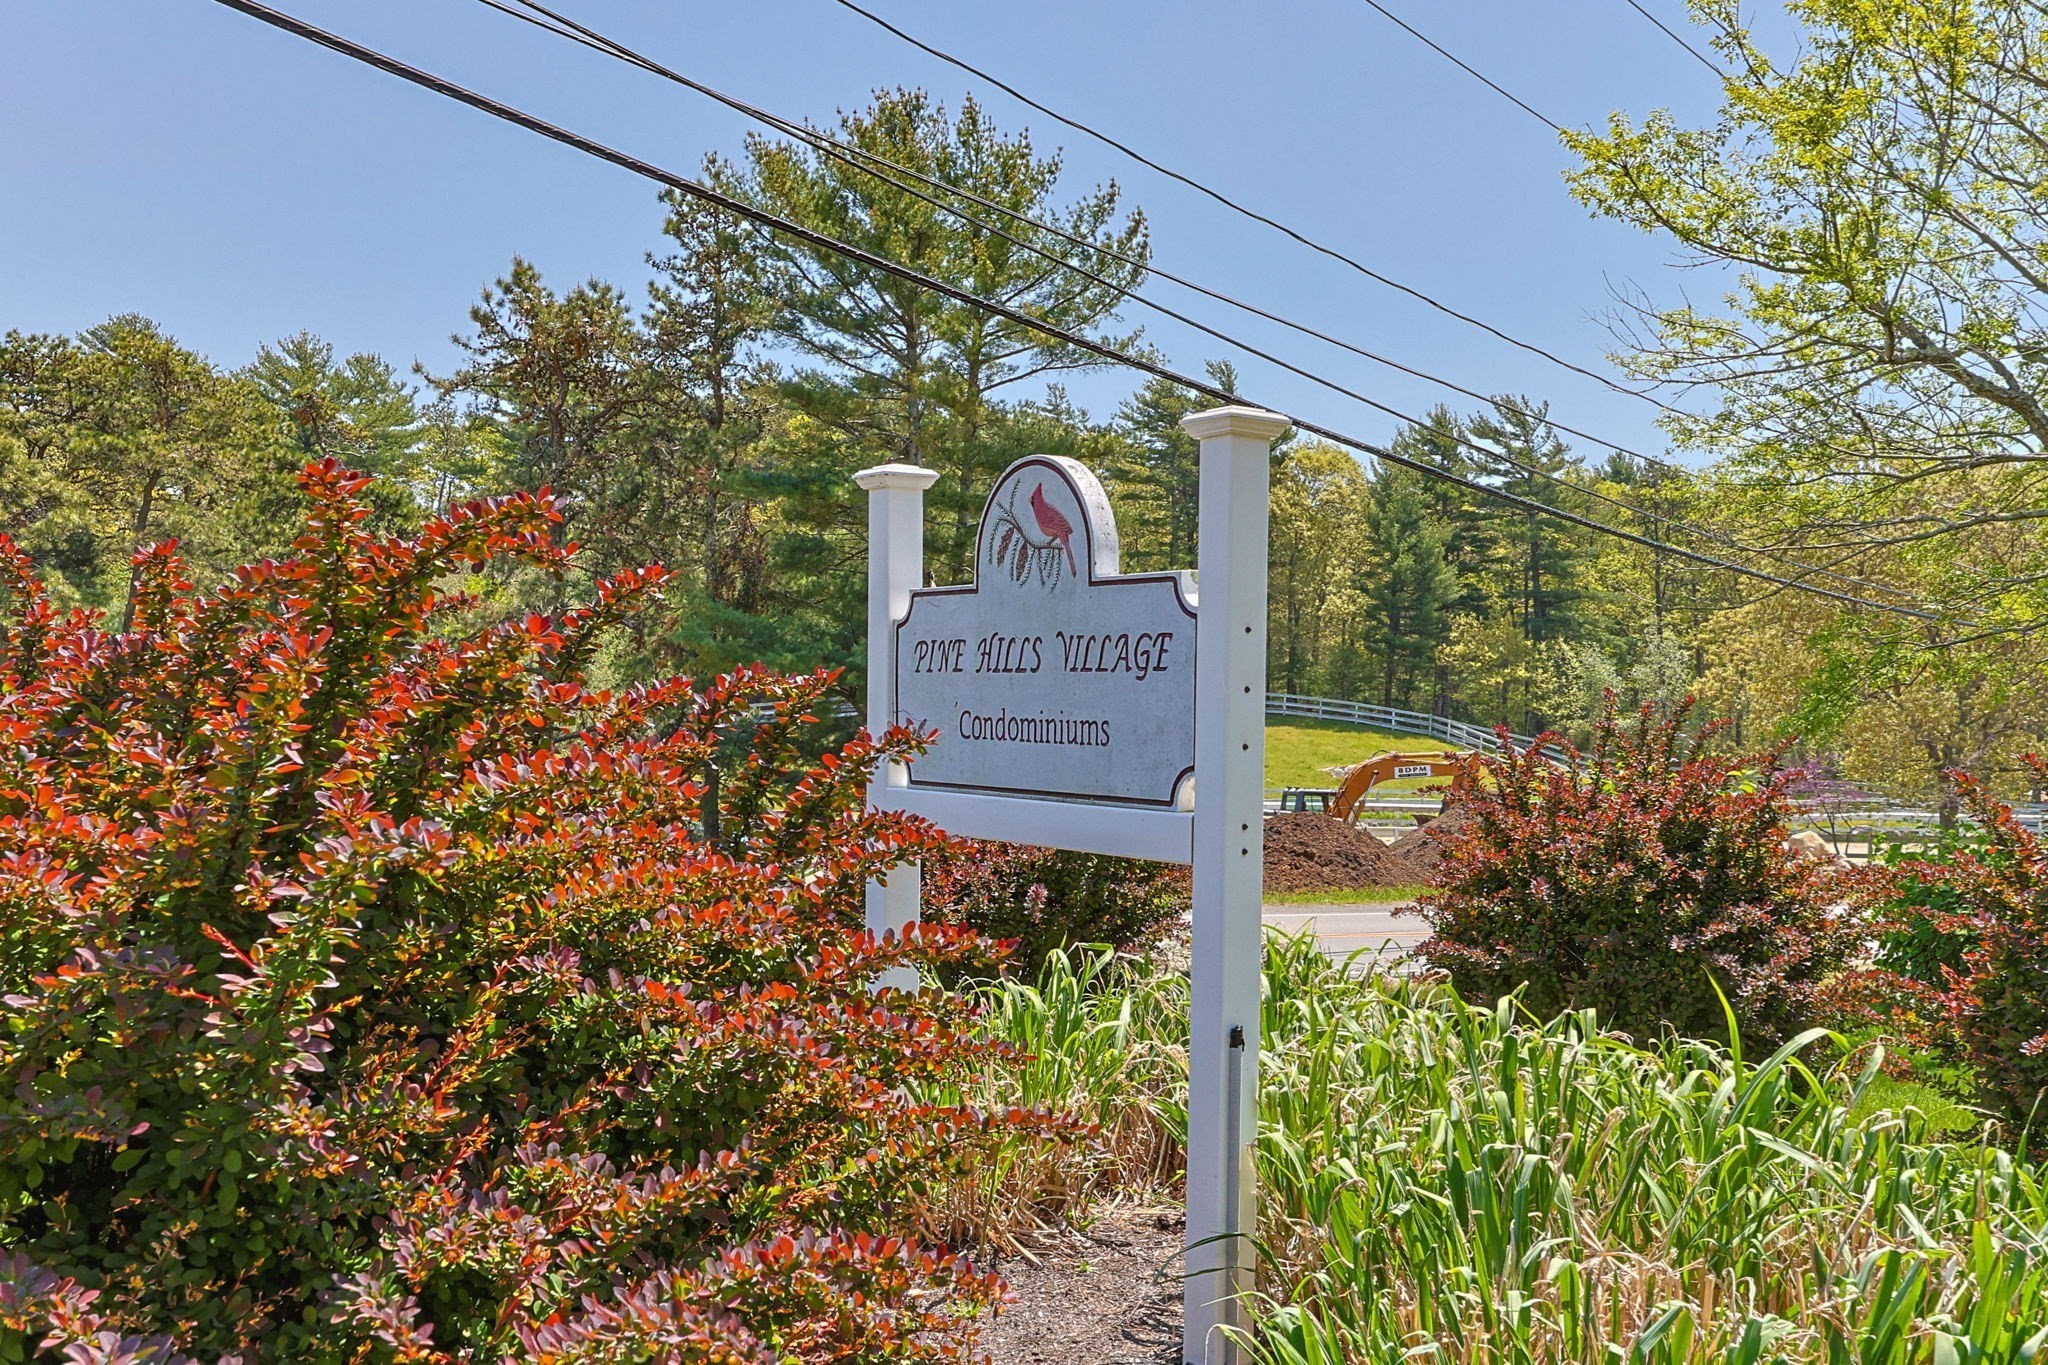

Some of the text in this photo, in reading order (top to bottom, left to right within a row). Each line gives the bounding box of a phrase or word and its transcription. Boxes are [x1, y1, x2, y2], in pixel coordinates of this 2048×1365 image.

[914, 631, 1173, 681] PINE HILLS VILLAGE
[959, 708, 1110, 747] Condominiums
